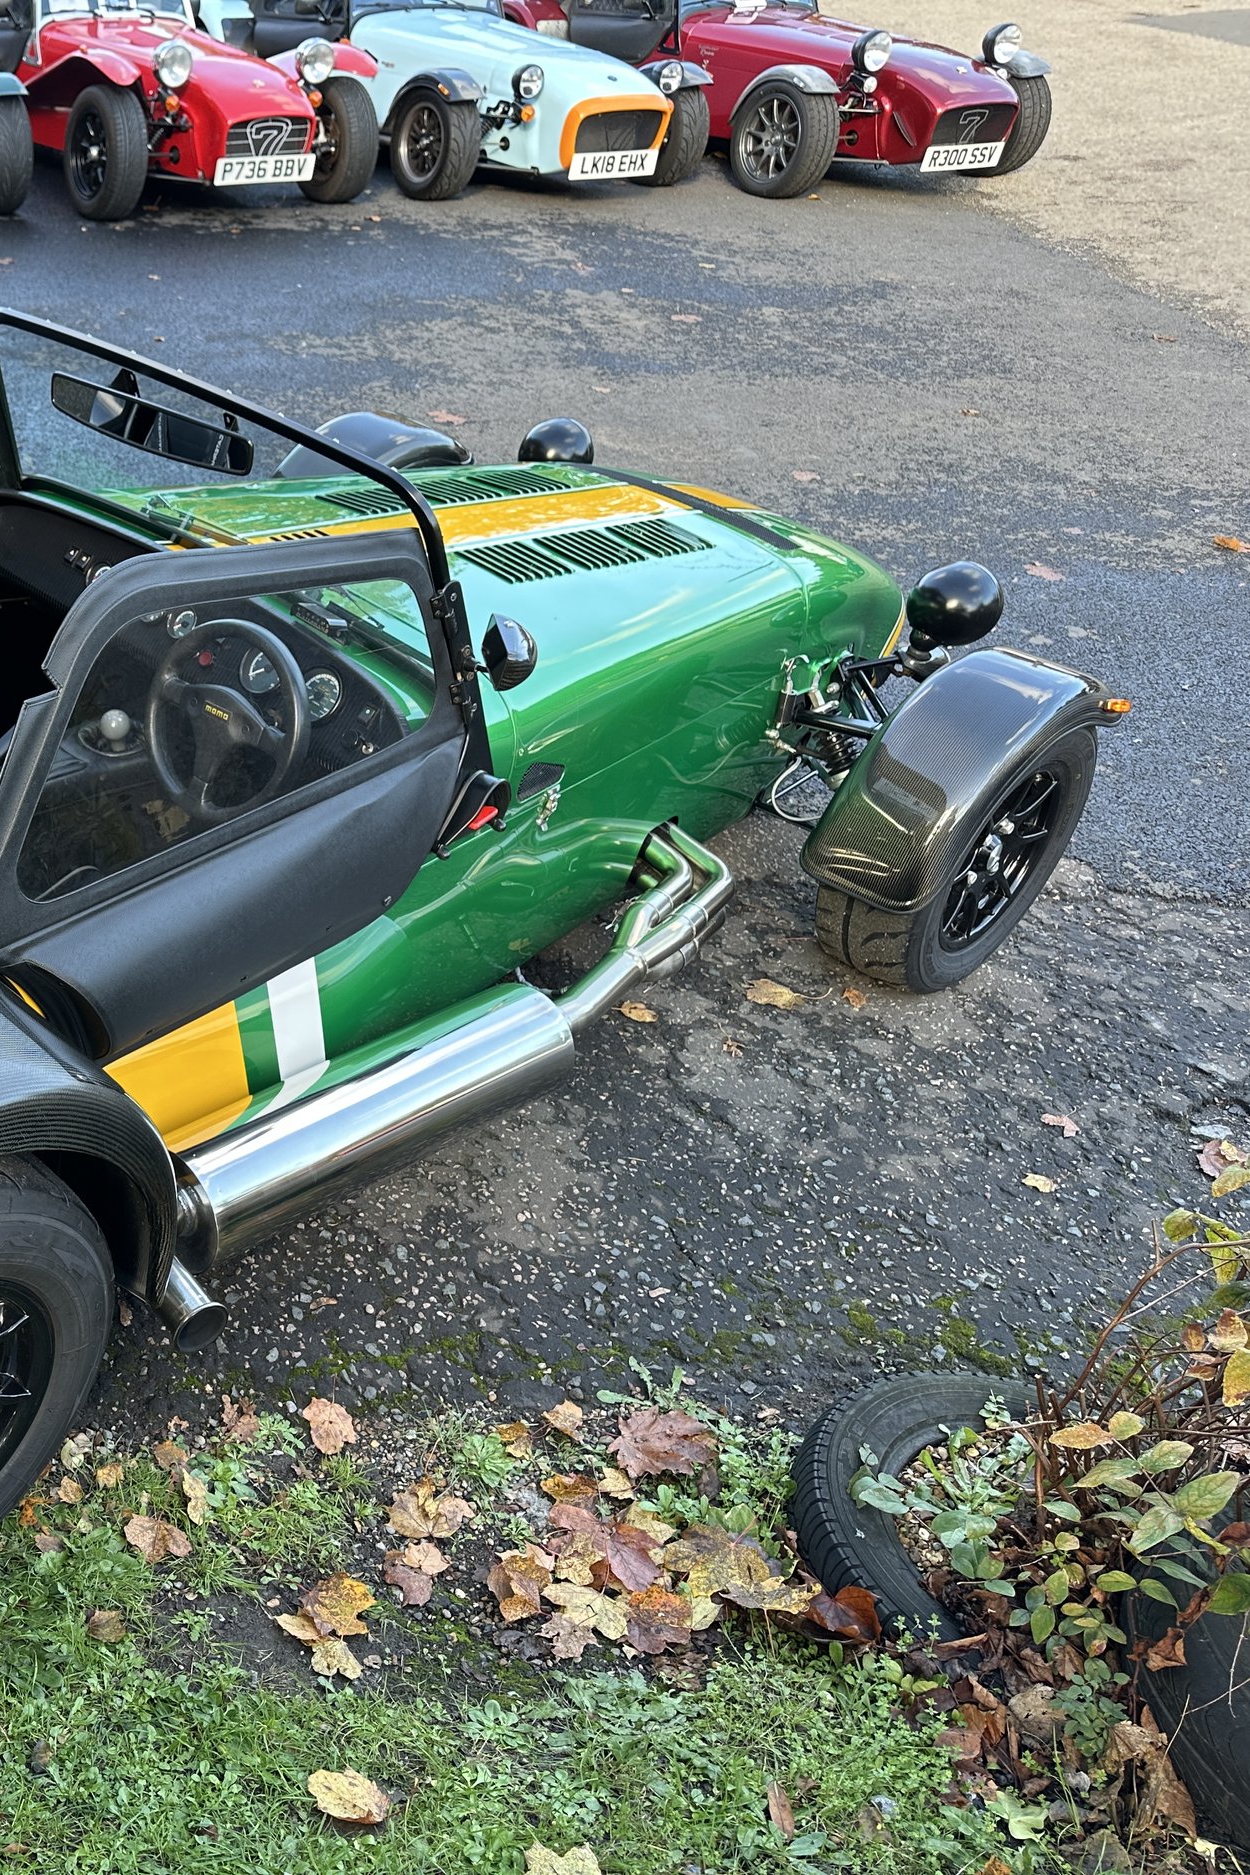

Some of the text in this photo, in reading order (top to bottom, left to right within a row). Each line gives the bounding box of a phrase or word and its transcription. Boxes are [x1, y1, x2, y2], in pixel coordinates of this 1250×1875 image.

[958, 108, 990, 144] 7
[251, 121, 288, 157] 7
[580, 153, 648, 175] LK18 EHX
[928, 145, 998, 168] R300 SSV
[221, 157, 307, 181] P736 BBV
